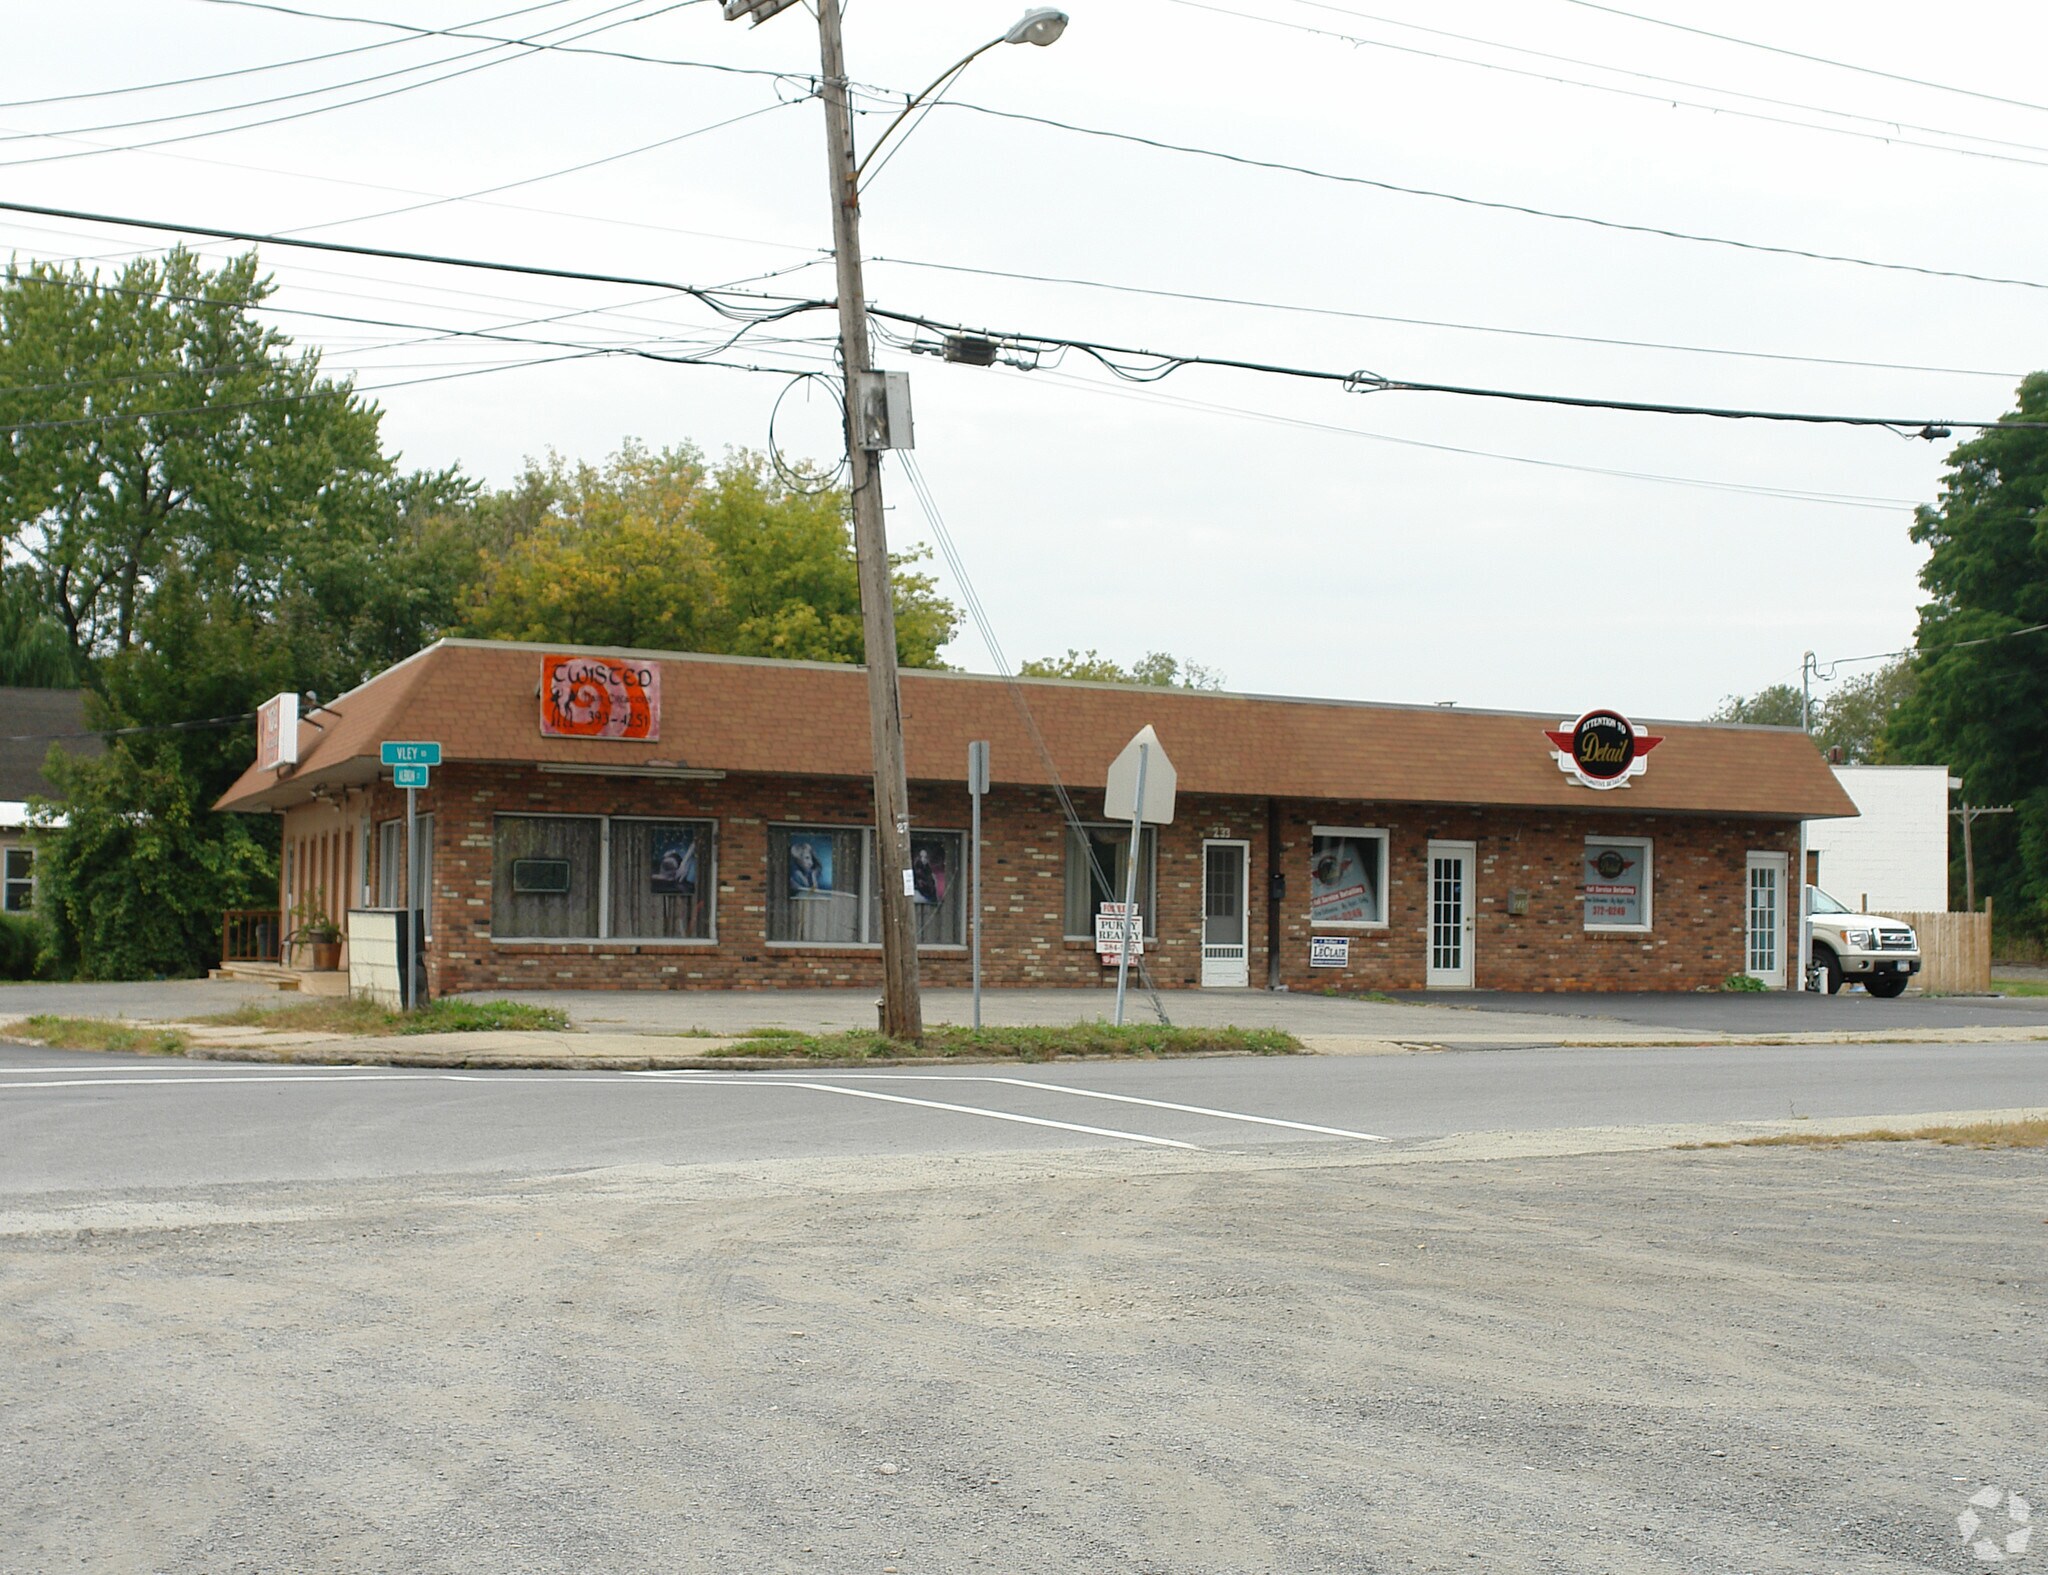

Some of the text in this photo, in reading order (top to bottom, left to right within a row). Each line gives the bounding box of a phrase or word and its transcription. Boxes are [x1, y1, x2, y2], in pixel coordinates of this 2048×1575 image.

[553, 664, 652, 688] TWISTED
[588, 711, 648, 728] 393-4251
[1581, 716, 1627, 735] ATTENTION TO
[396, 746, 418, 761] VLEY
[1580, 732, 1629, 762] Detail
[1101, 921, 1138, 931] PURY
[1099, 930, 1141, 941] REAY
